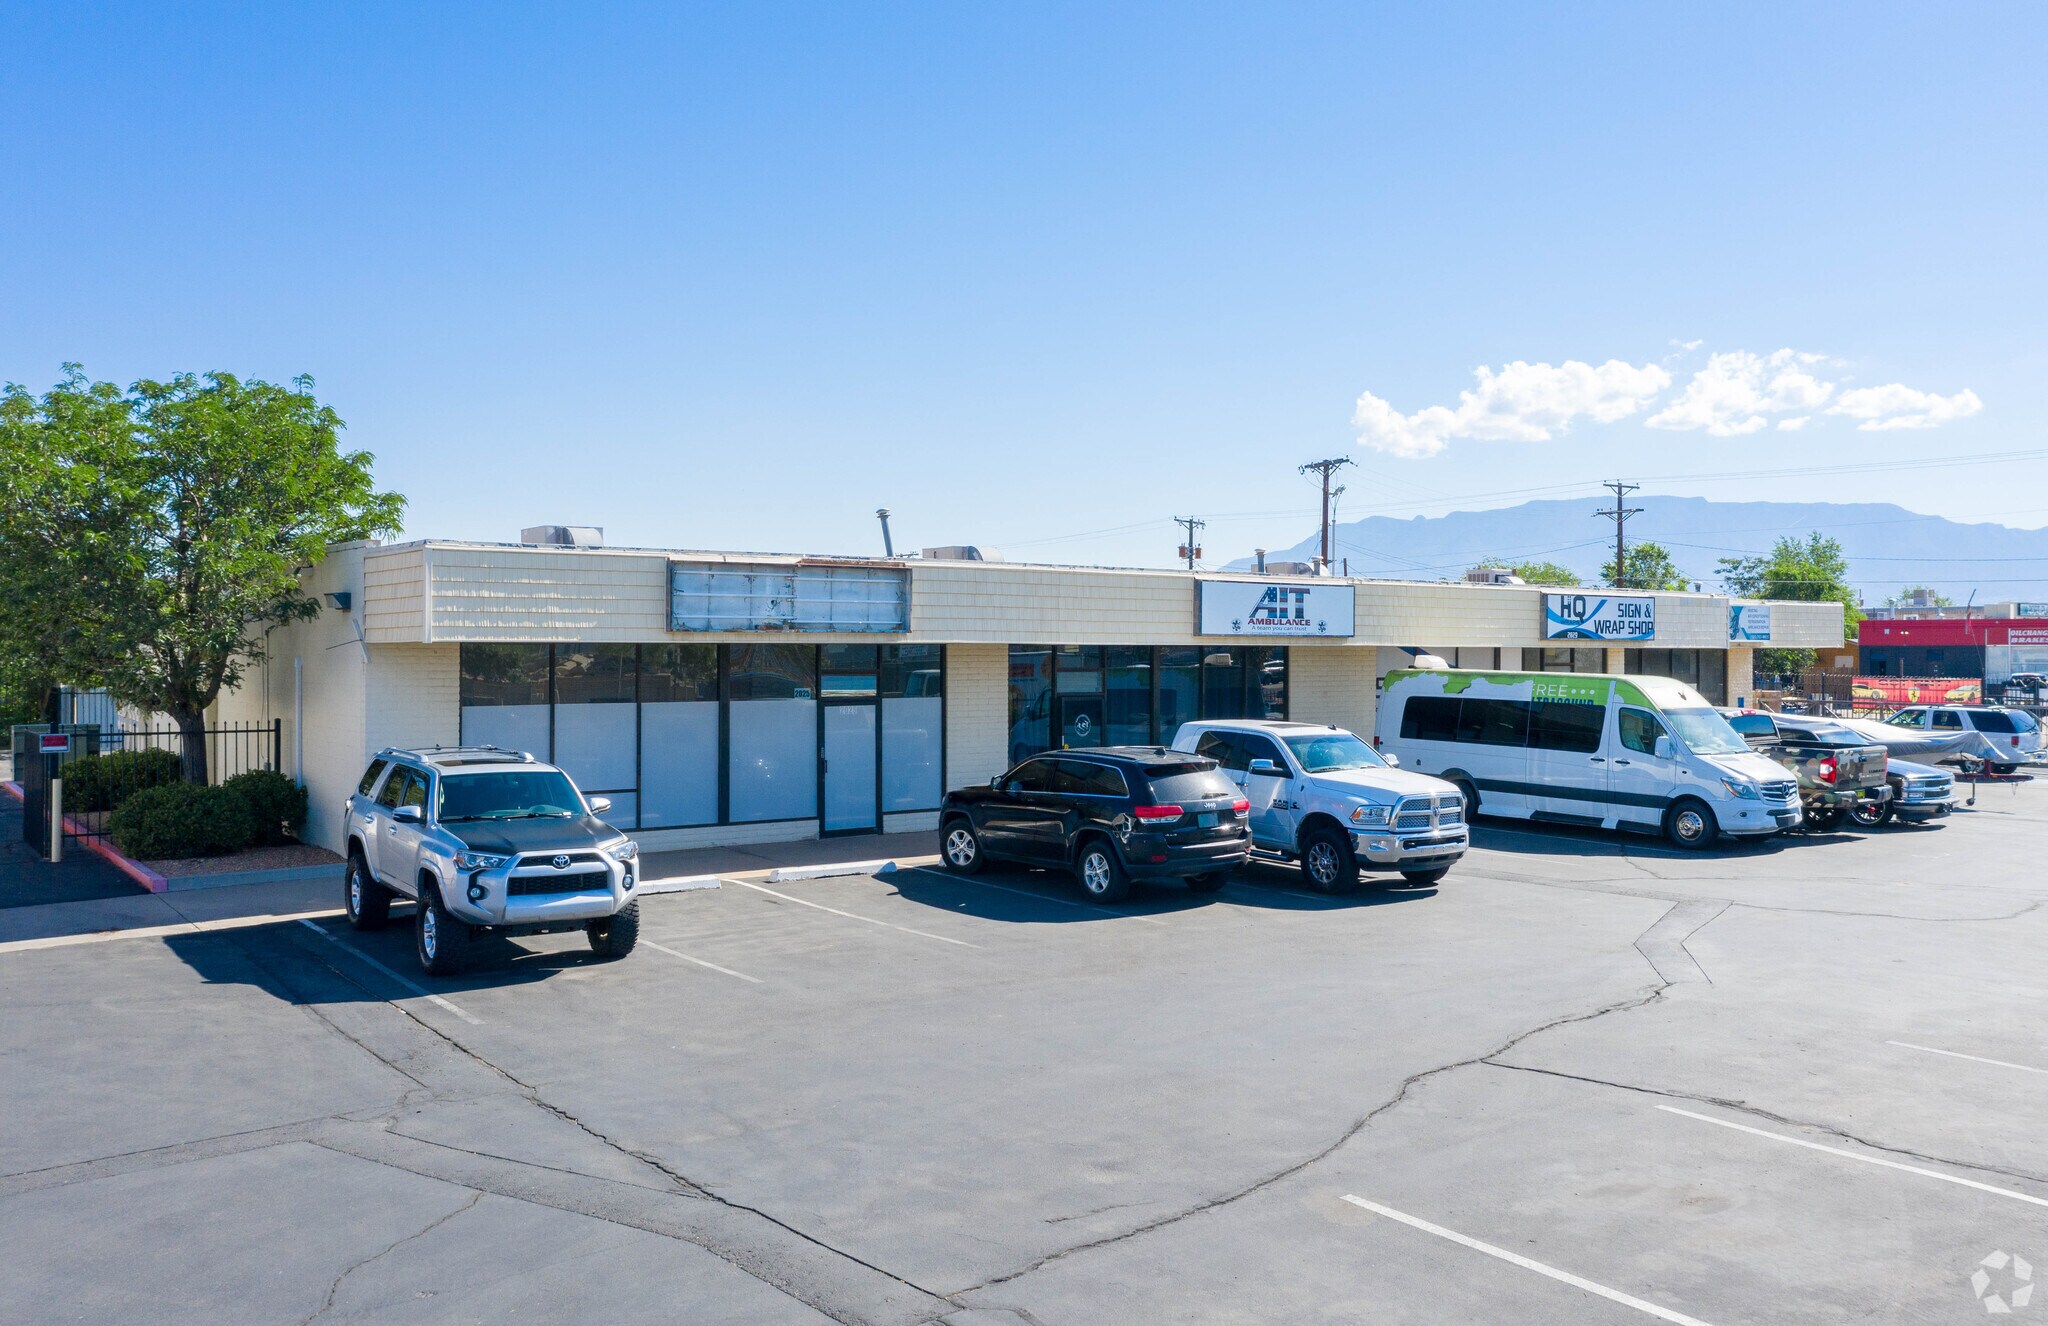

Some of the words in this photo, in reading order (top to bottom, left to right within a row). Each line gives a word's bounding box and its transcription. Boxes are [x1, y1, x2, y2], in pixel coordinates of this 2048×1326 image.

[1248, 587, 1311, 619] AIT
[1560, 595, 1586, 624] HQ
[1617, 603, 1641, 618] SIGN
[1644, 603, 1652, 618] &
[1247, 618, 1311, 626] AMBULANCE
[1594, 619, 1625, 634] WRAP
[1627, 621, 1654, 635] SHOP
[794, 689, 810, 698] 2025
